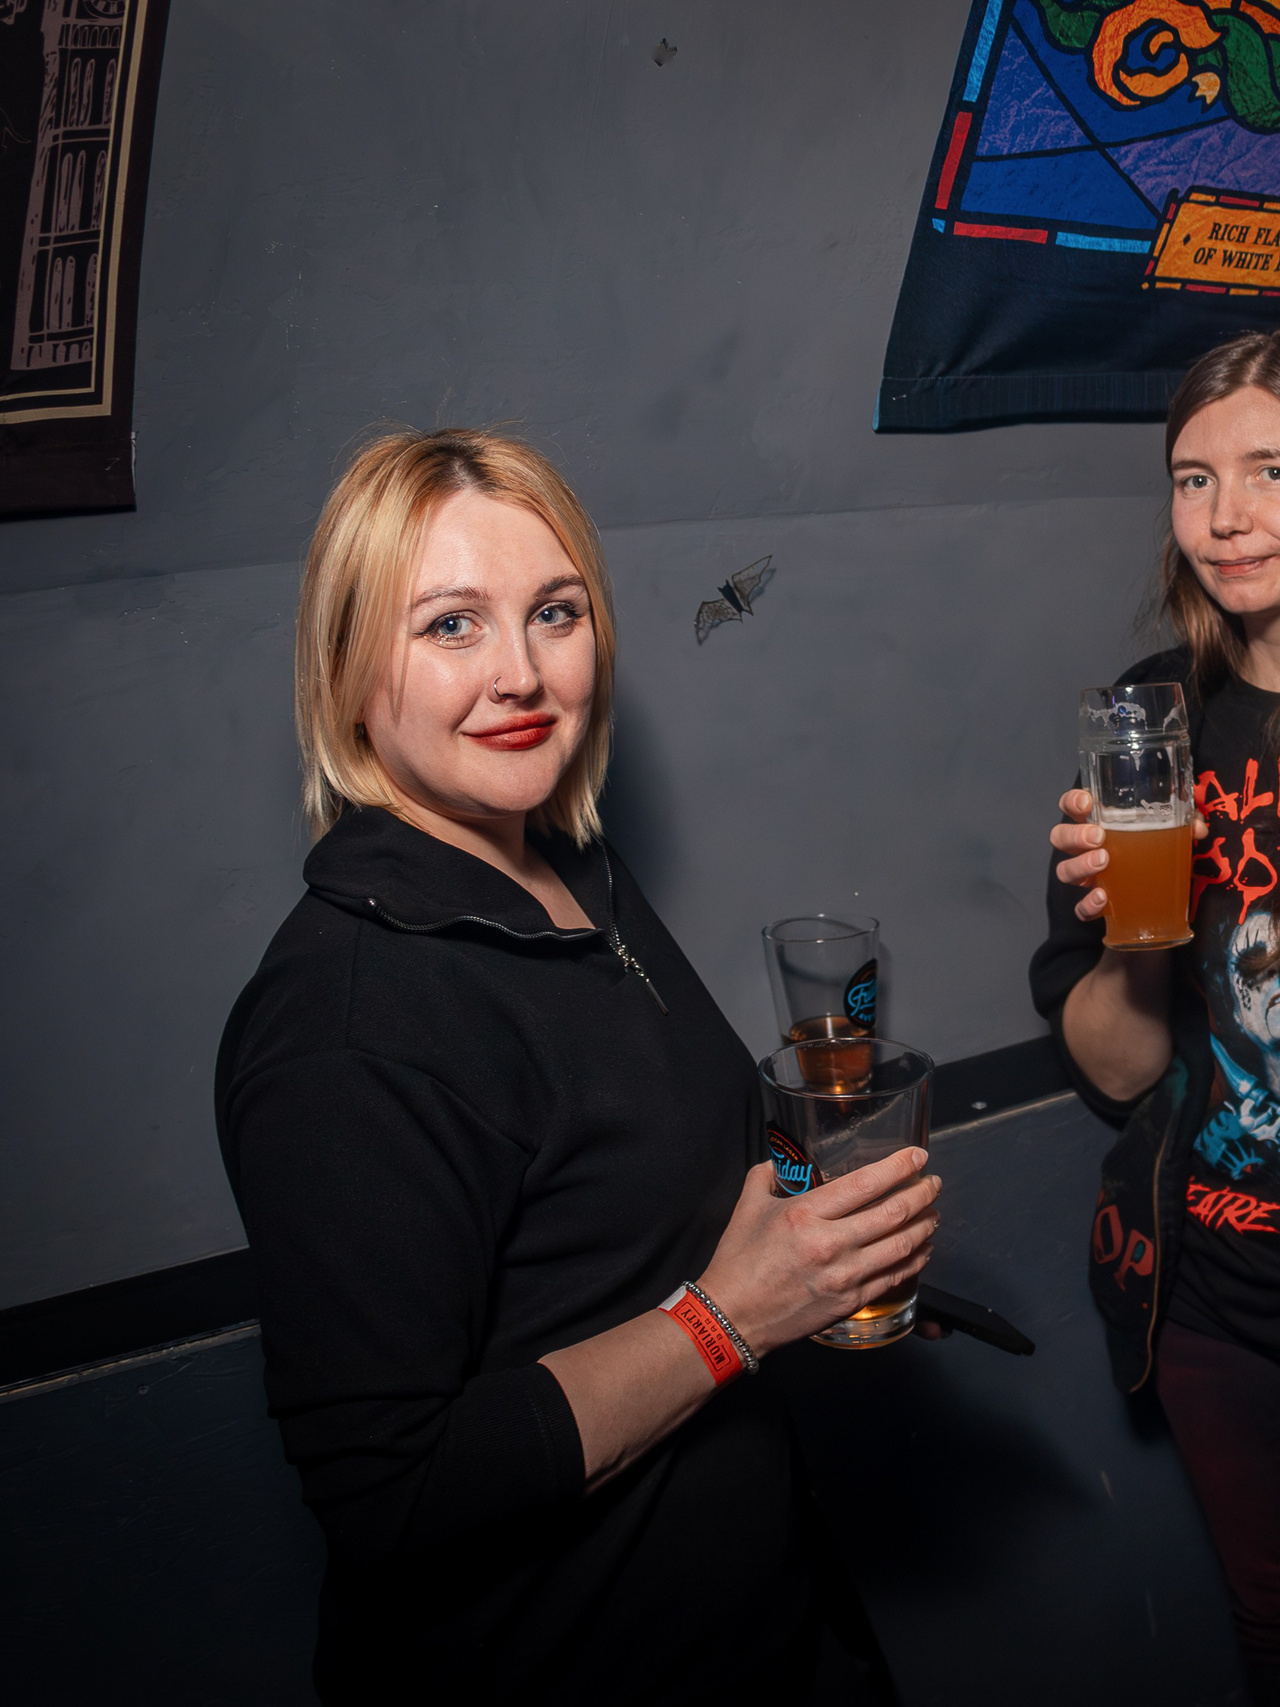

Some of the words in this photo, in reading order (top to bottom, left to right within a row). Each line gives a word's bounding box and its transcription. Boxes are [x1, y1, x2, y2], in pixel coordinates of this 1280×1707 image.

[1207, 222, 1250, 244] RICH
[1193, 247, 1216, 266] OF
[1221, 249, 1273, 271] WHITE
[680, 1308, 726, 1365] MORIARTY
[704, 1318, 723, 1341] BAR
